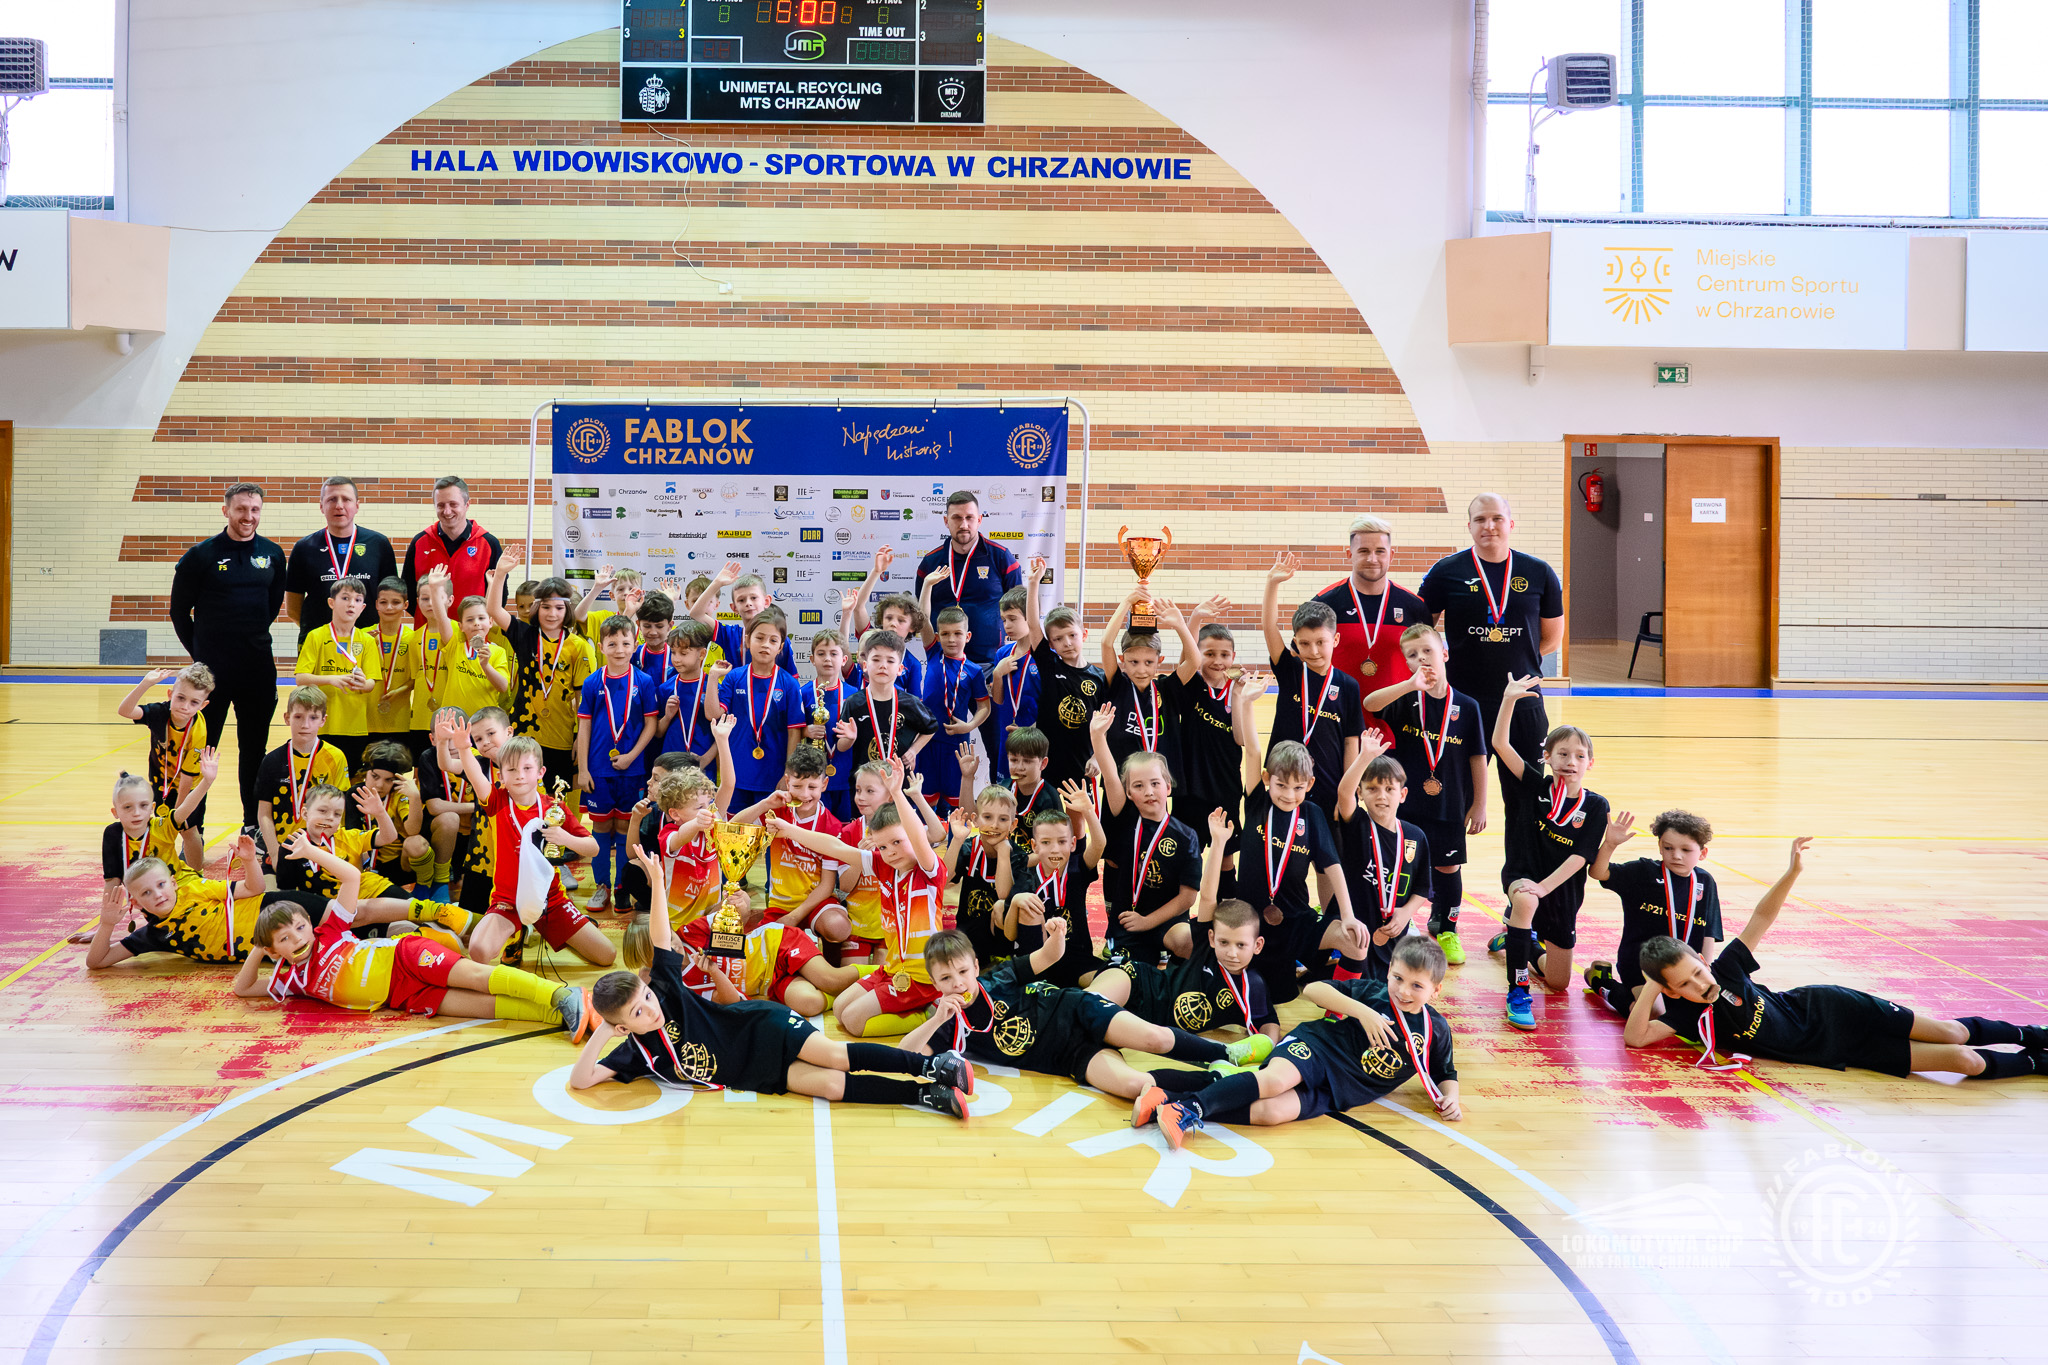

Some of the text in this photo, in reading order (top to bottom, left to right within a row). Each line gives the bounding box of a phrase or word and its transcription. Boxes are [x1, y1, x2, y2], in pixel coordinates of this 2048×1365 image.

[624, 28, 631, 39] 3
[678, 28, 685, 39] 3
[858, 27, 905, 38] TIME OUT
[920, 31, 926, 42] 3
[976, 32, 983, 42] 6
[719, 80, 882, 96] UNIMETAL RECYCLING
[945, 88, 958, 96] MTS
[740, 96, 861, 110] MTS CHRZANÓW
[411, 150, 499, 172] HALA
[513, 150, 743, 175] WIDOWISKOWO
[764, 153, 936, 177] SPORTOWA
[947, 155, 975, 177] W
[987, 156, 1192, 180] CHRZANOWIE
[1696, 248, 1776, 270] Miejskie
[1697, 274, 1860, 296] Centrum Sportu
[1696, 301, 1836, 320] w Chrzanowie
[624, 418, 753, 444] FABLOK
[623, 443, 754, 465] CHRZANÓW
[717, 934, 741, 943] MIEJSCE
[1179, 997, 1202, 1030] KOLEX
[1007, 1019, 1031, 1054] KOLEX
